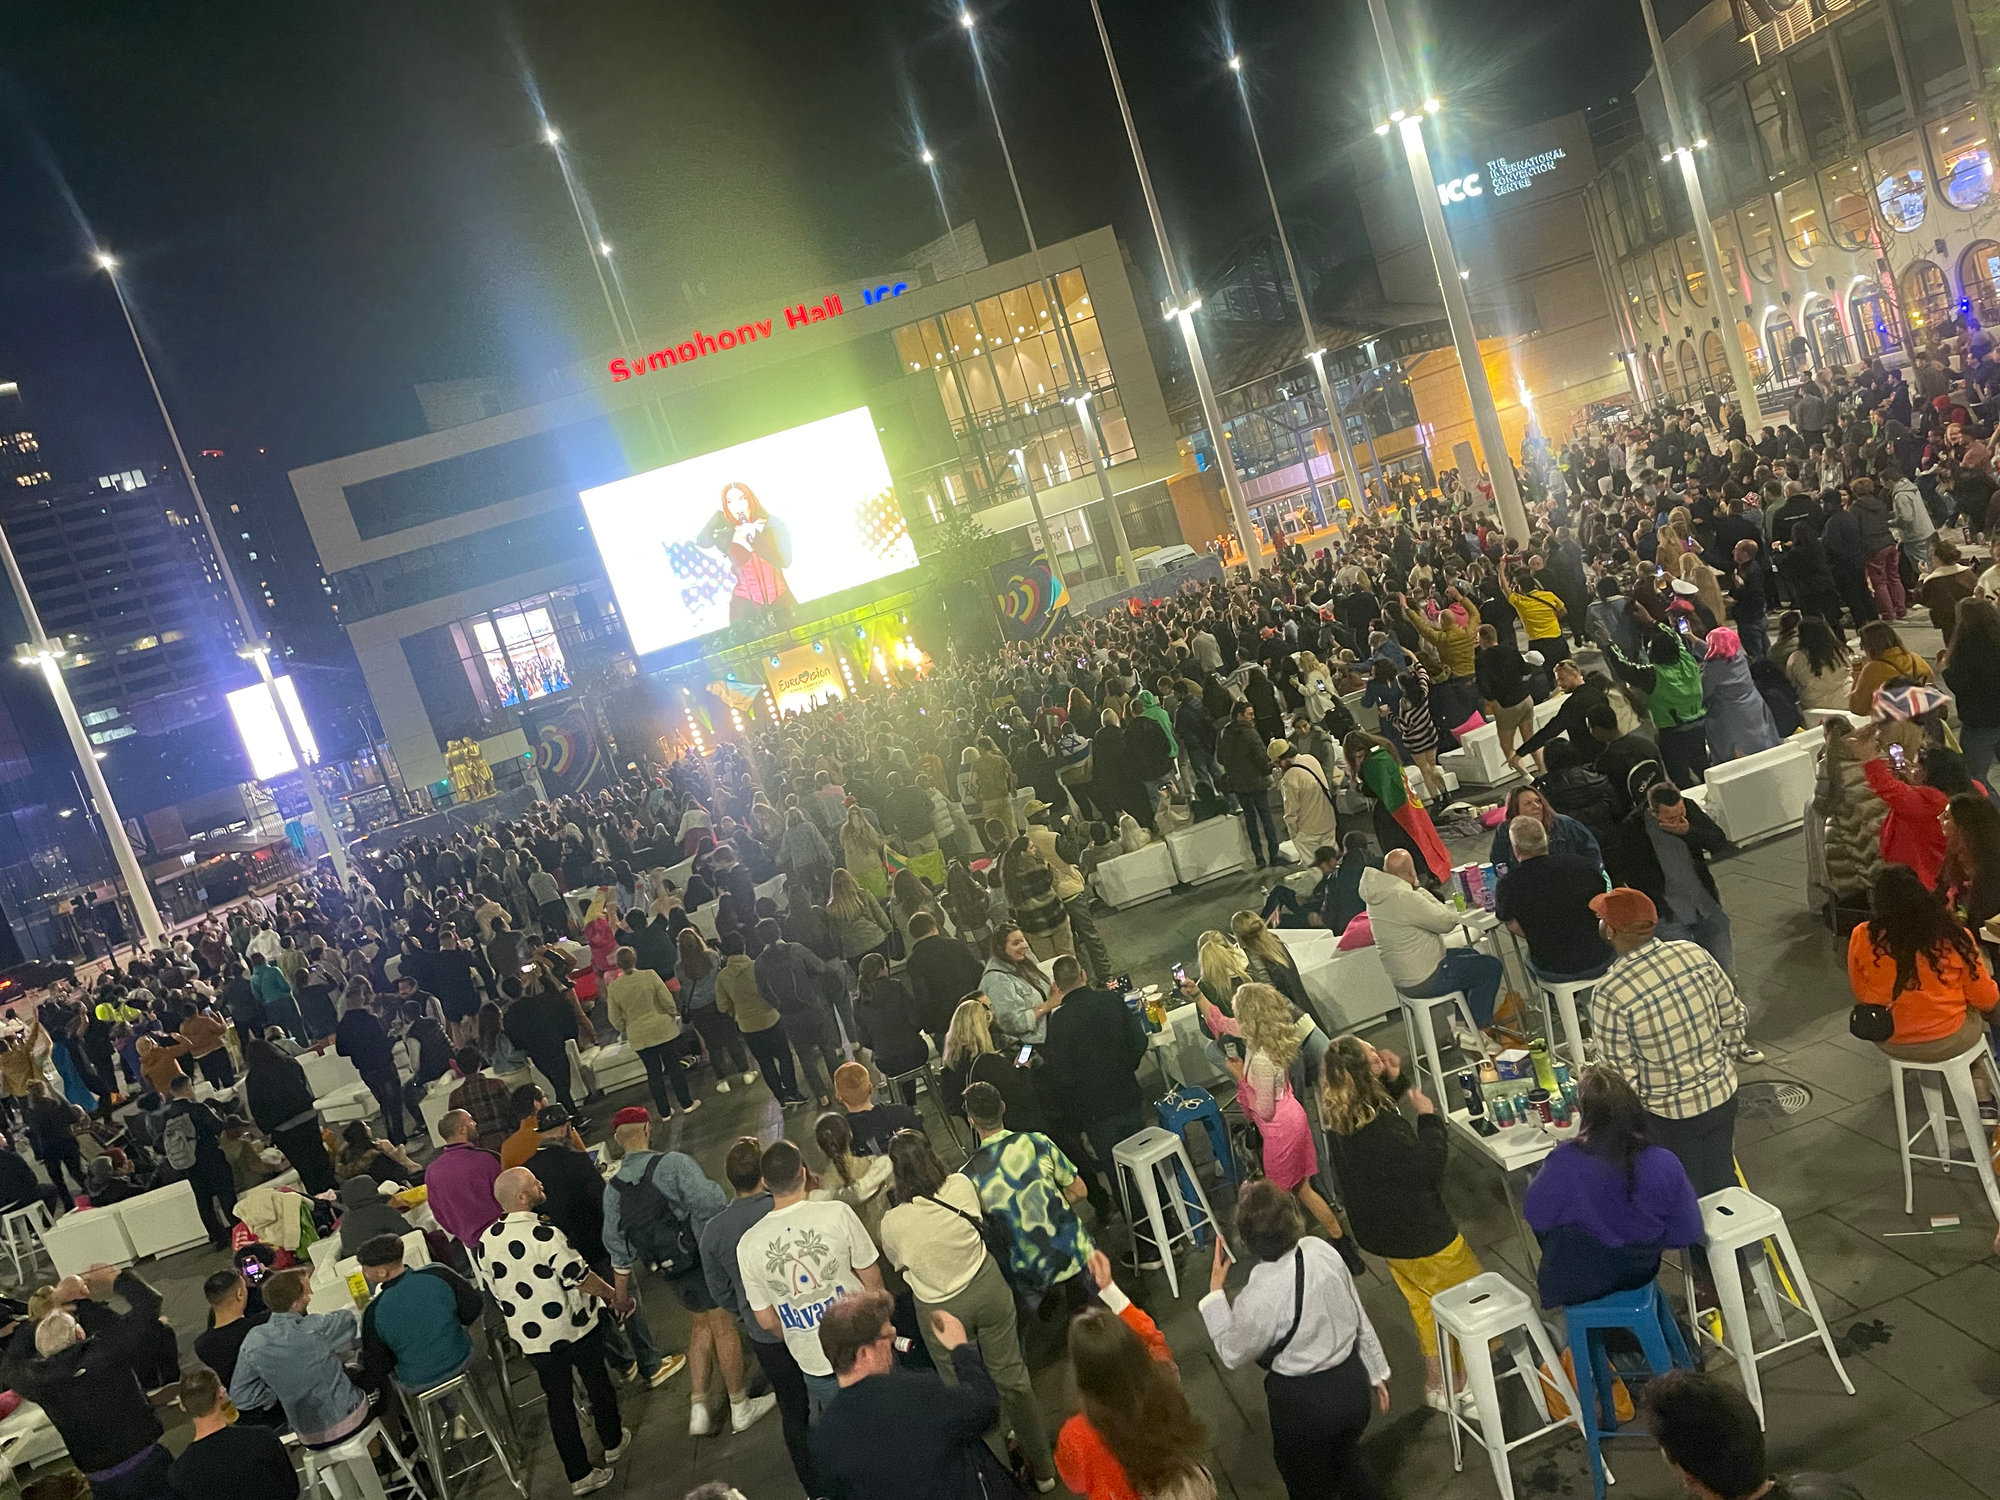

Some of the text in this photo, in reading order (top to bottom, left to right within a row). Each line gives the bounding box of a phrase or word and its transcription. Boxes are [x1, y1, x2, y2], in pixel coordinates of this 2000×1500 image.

[1486, 157, 1507, 169] THE
[1489, 148, 1567, 179] INTERNATIONAL
[1492, 161, 1556, 187] CONVENTION
[1436, 173, 1483, 206] ICC
[1494, 178, 1532, 197] CENTRE
[608, 318, 773, 383] Symphony
[783, 294, 844, 331] Hall
[778, 1285, 847, 1329] Hava
